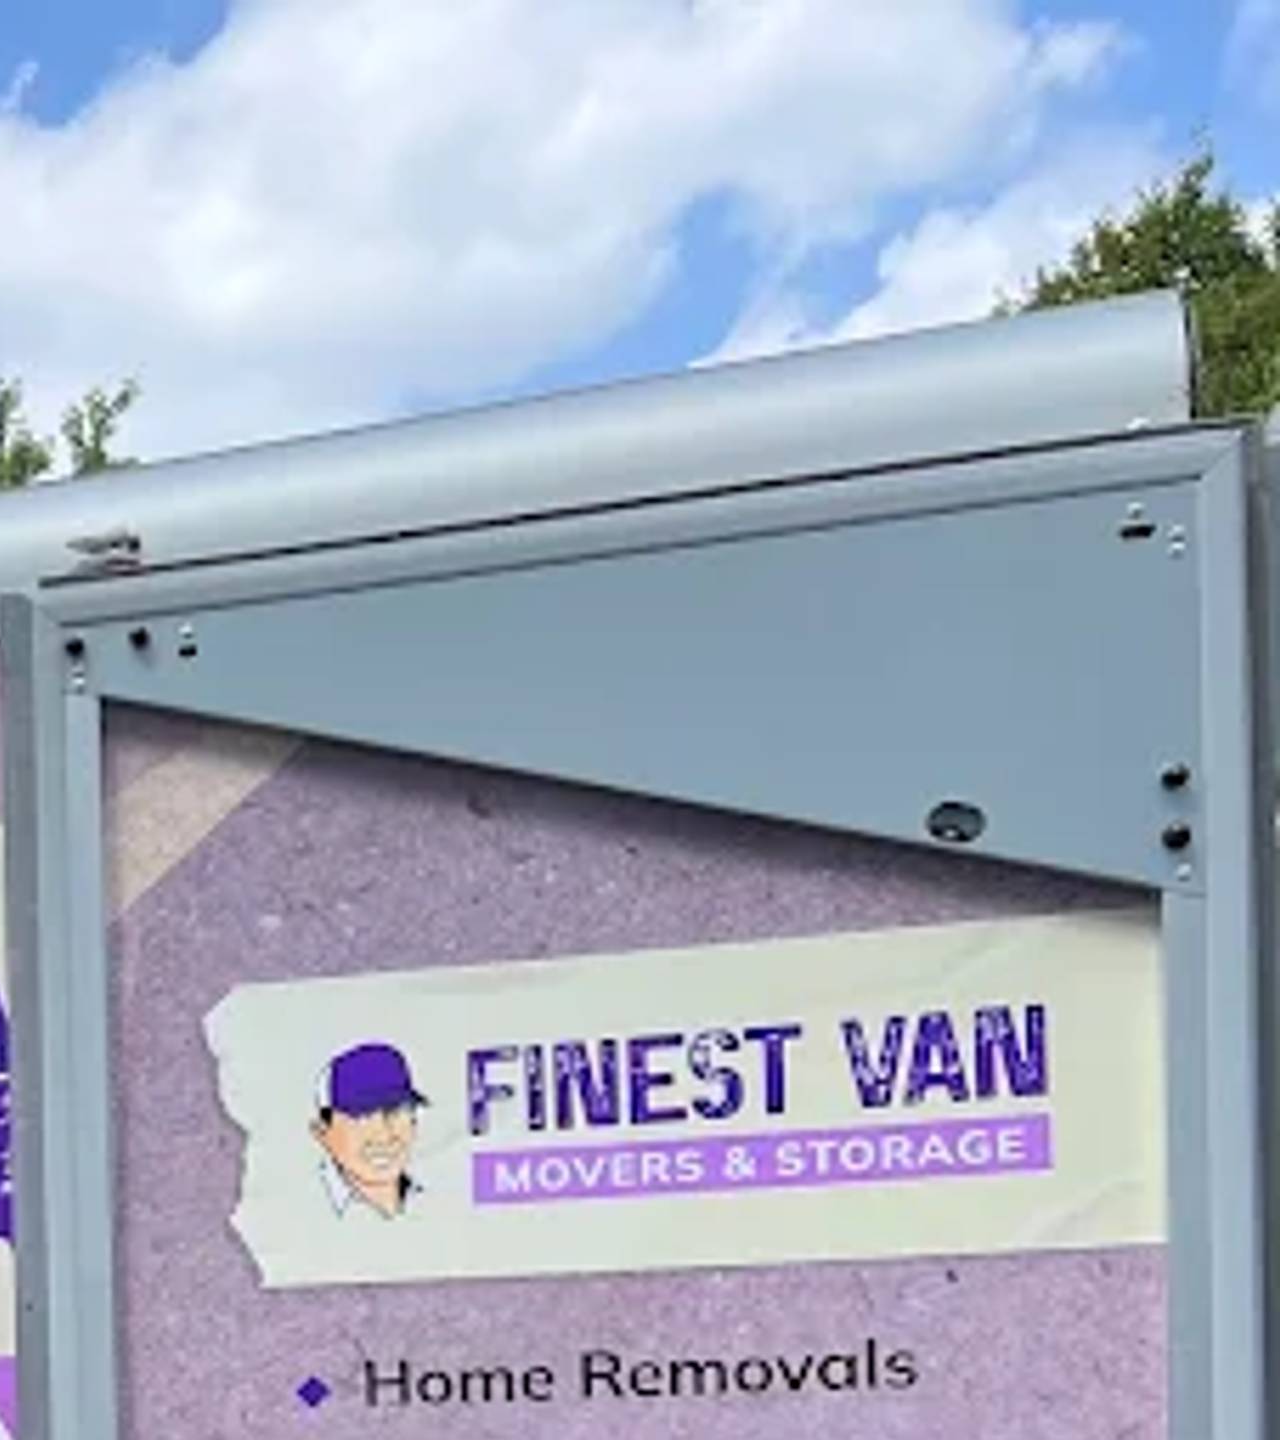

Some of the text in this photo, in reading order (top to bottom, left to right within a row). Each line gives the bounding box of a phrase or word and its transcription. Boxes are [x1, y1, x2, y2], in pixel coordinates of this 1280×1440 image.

[466, 1003, 1050, 1136] FINEST VAN
[493, 1125, 1028, 1195] MOVERS & STORAGE
[363, 1338, 920, 1407] Home Removals
